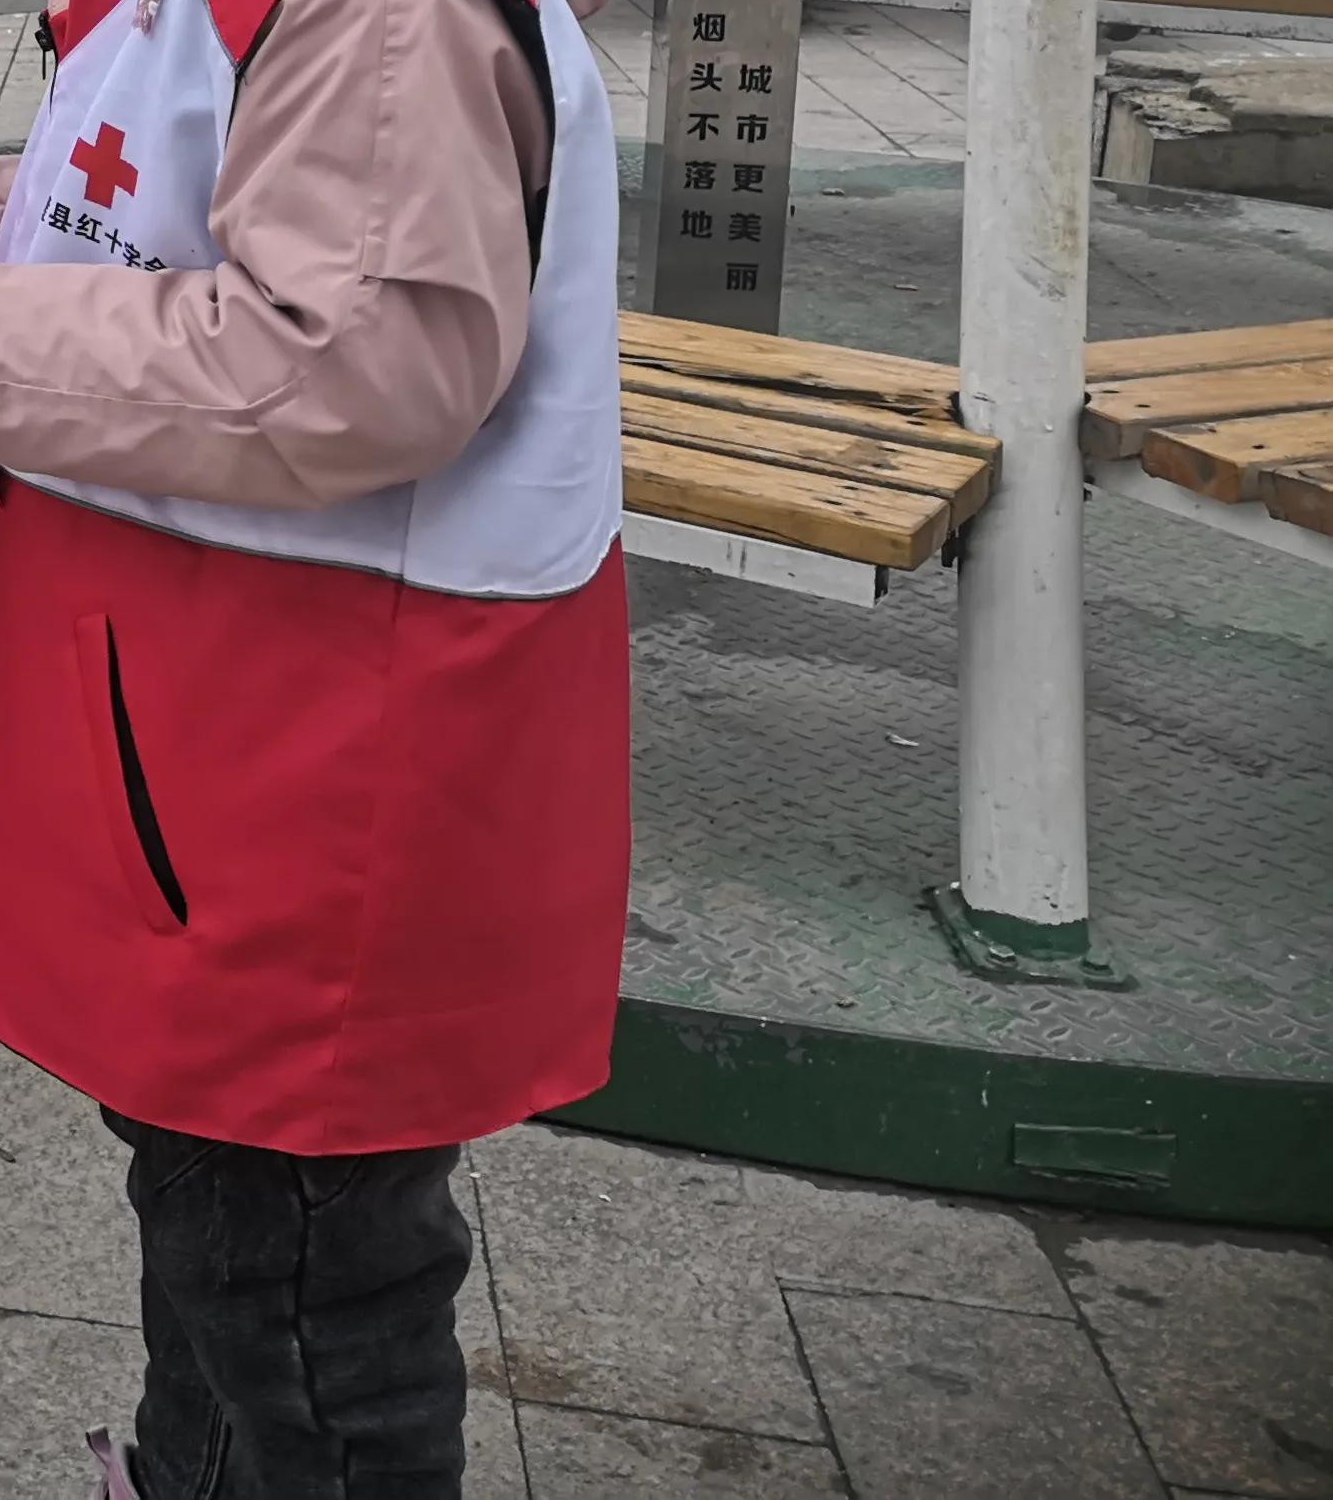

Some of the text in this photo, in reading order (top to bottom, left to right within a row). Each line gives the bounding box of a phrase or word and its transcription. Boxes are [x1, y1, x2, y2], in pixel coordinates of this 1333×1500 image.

[41, 195, 168, 273] 县红十字会
[680, 11, 727, 241] 烟头不落地
[725, 62, 773, 294] 城市更美丽
